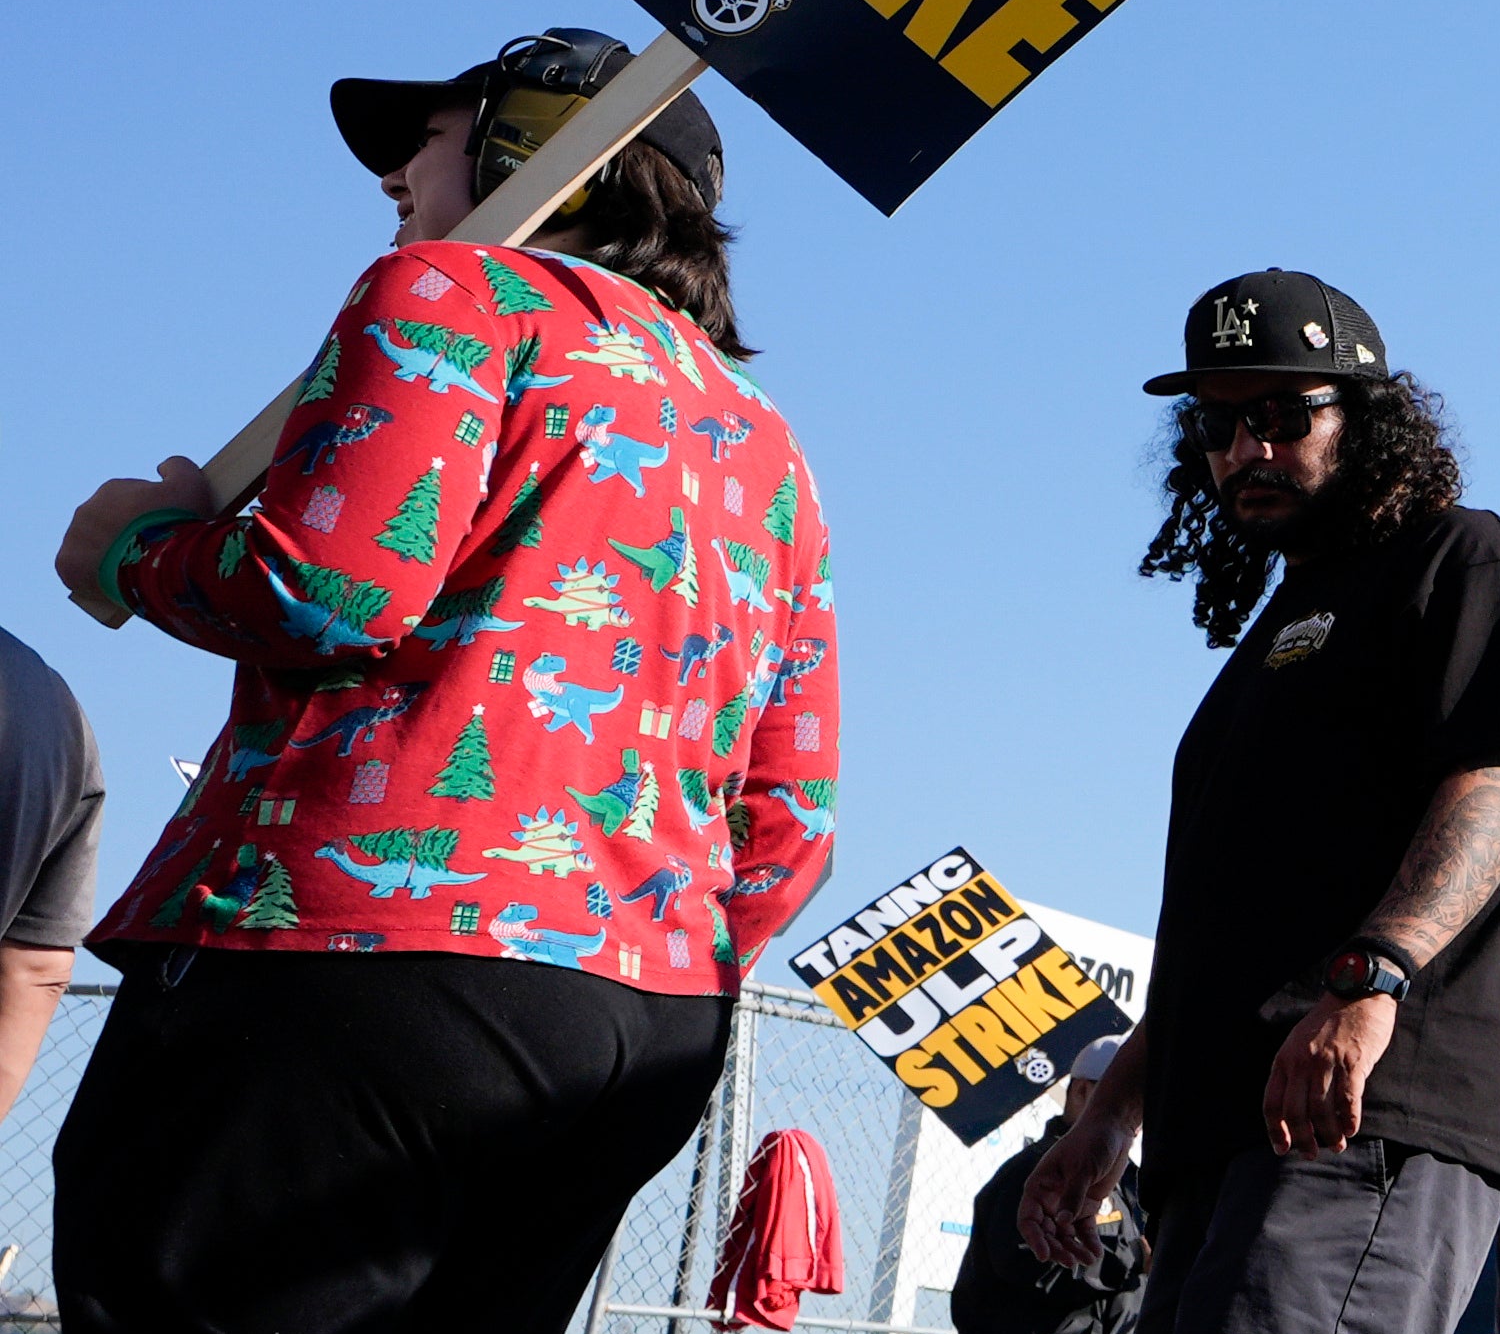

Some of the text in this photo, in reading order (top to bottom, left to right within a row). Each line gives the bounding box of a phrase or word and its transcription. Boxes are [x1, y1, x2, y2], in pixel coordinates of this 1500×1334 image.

[794, 854, 973, 979] TANNC
[828, 878, 1016, 1021] AMAZON
[1068, 951, 1135, 1002] zon
[855, 918, 1042, 1057] ULP
[895, 945, 1103, 1108] STRIKE
